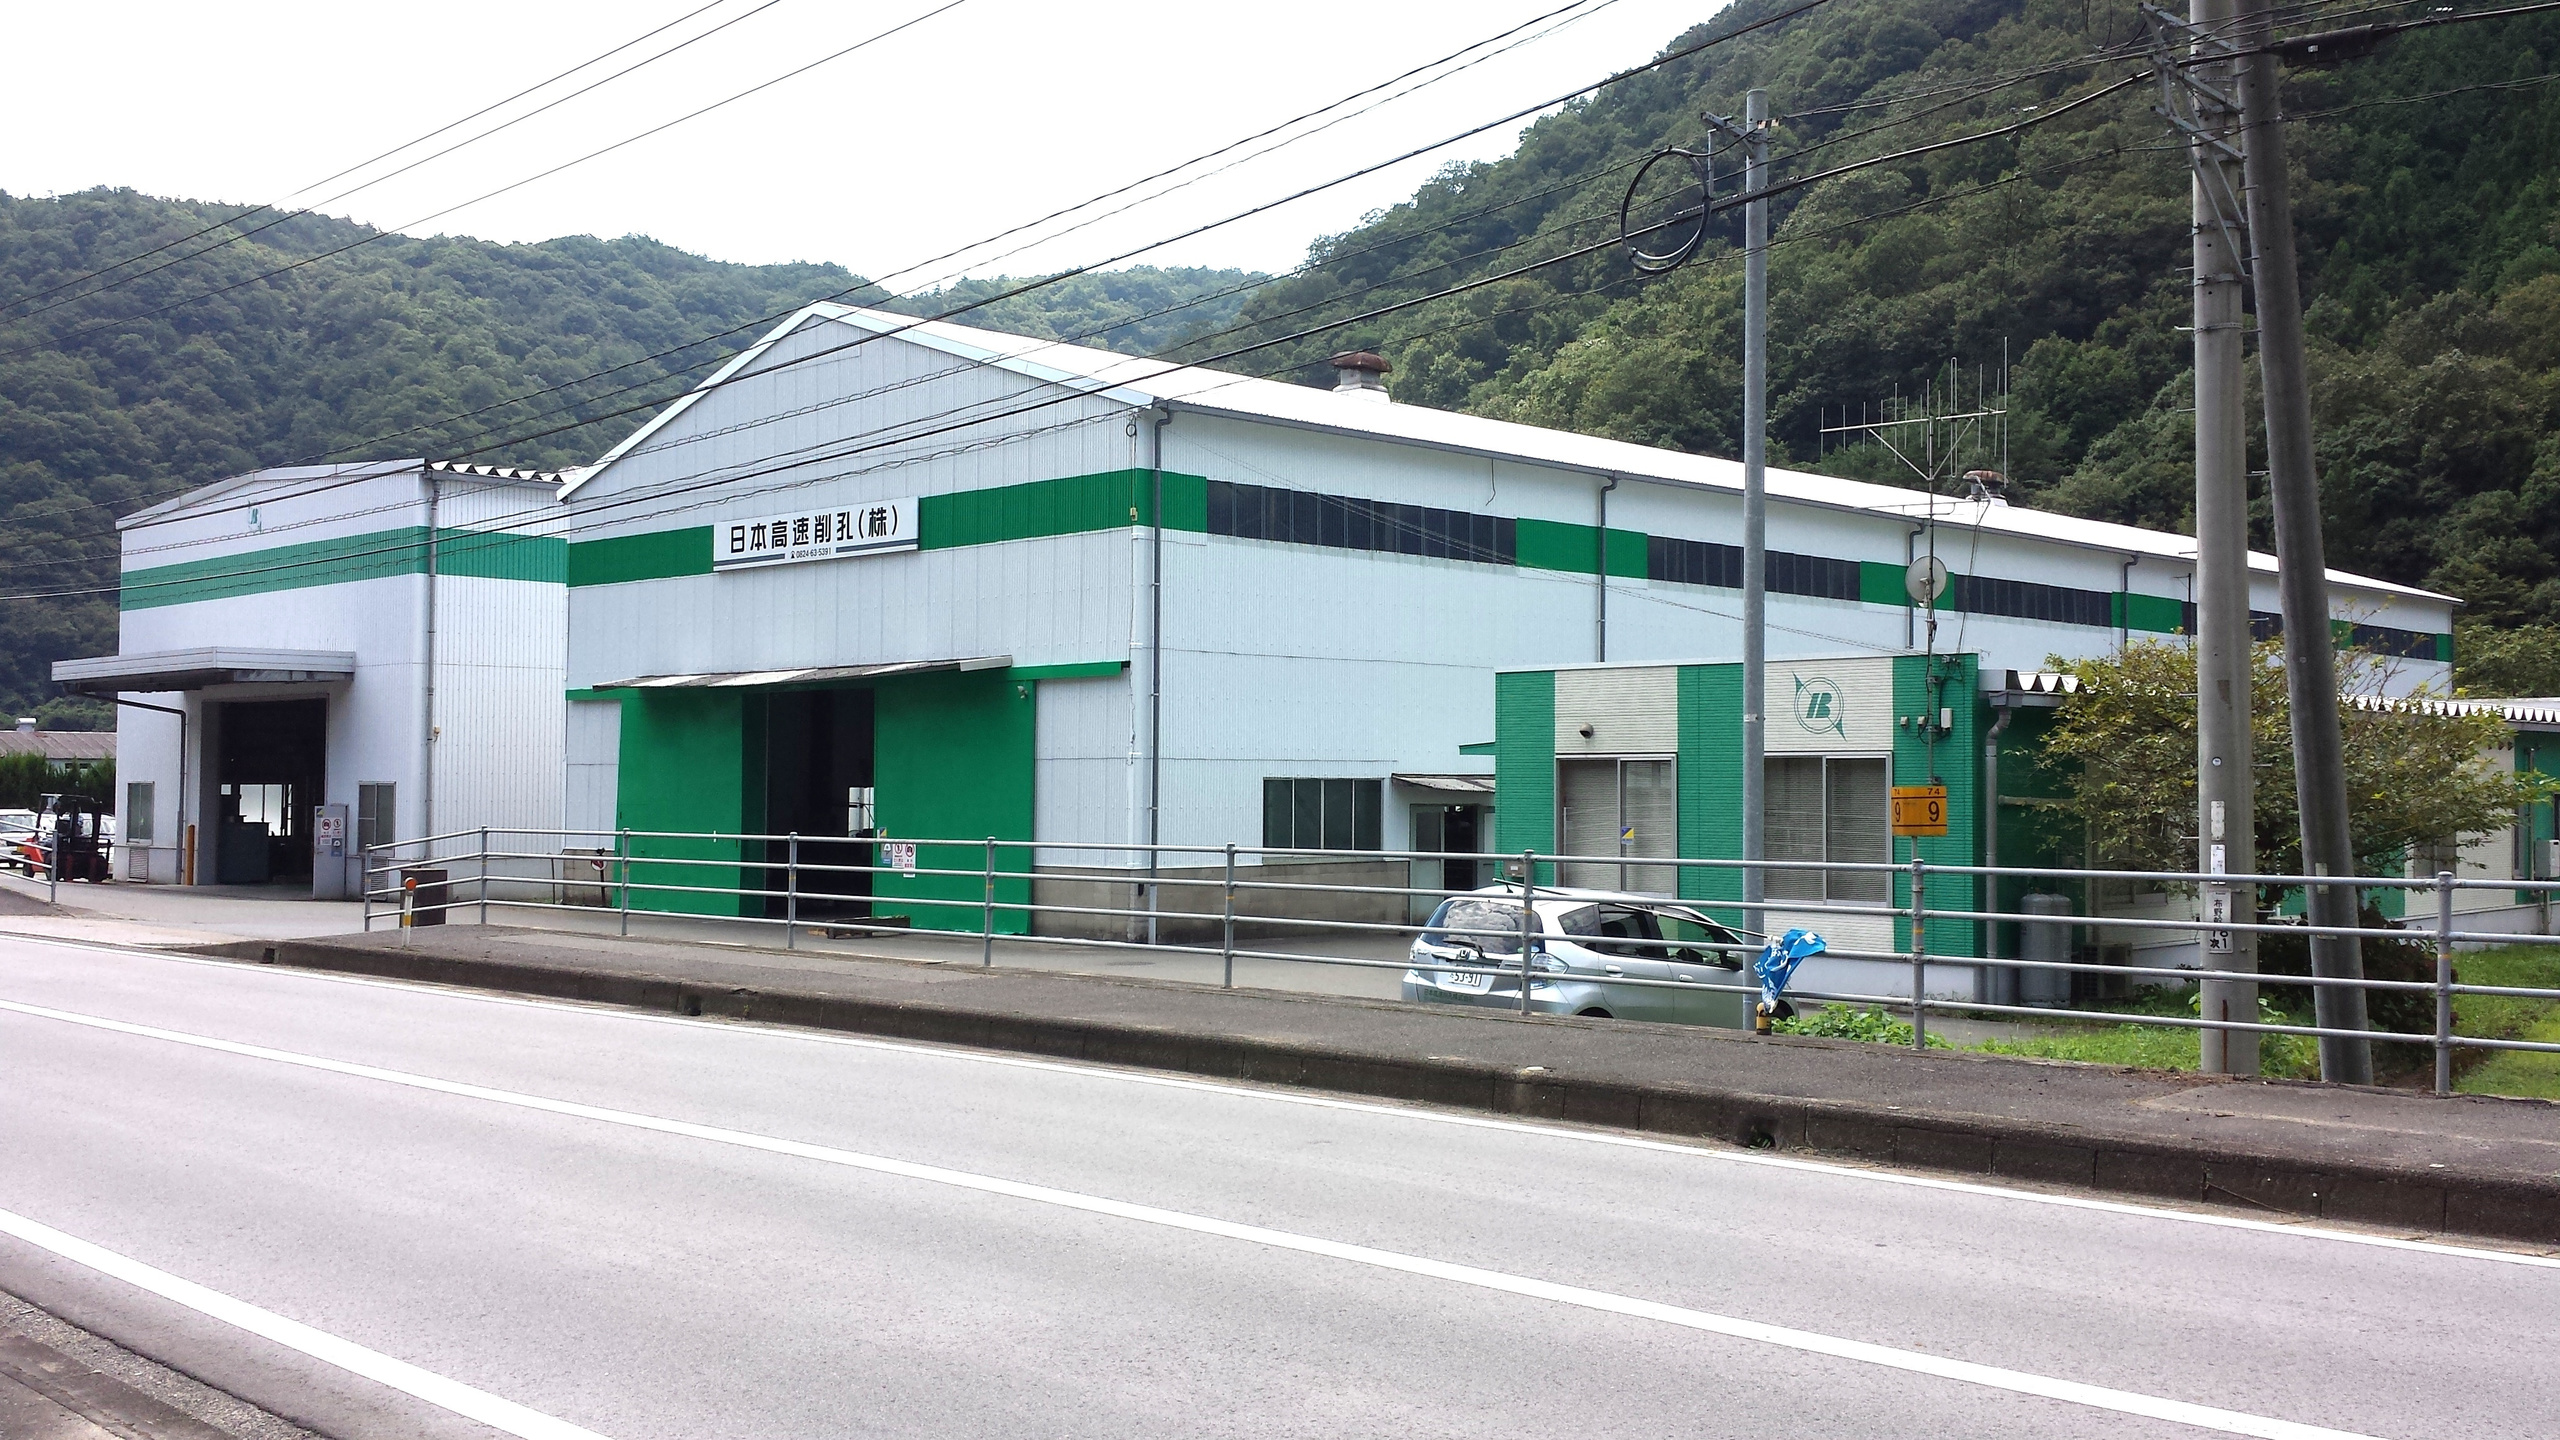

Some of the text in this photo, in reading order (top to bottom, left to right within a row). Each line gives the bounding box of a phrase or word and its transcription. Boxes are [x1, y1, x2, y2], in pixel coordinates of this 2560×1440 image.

[730, 505, 898, 554] 日本高速削孔(株)
[1927, 787, 1940, 796] 74
[1894, 801, 1901, 823] 9
[1928, 800, 1940, 823] 9
